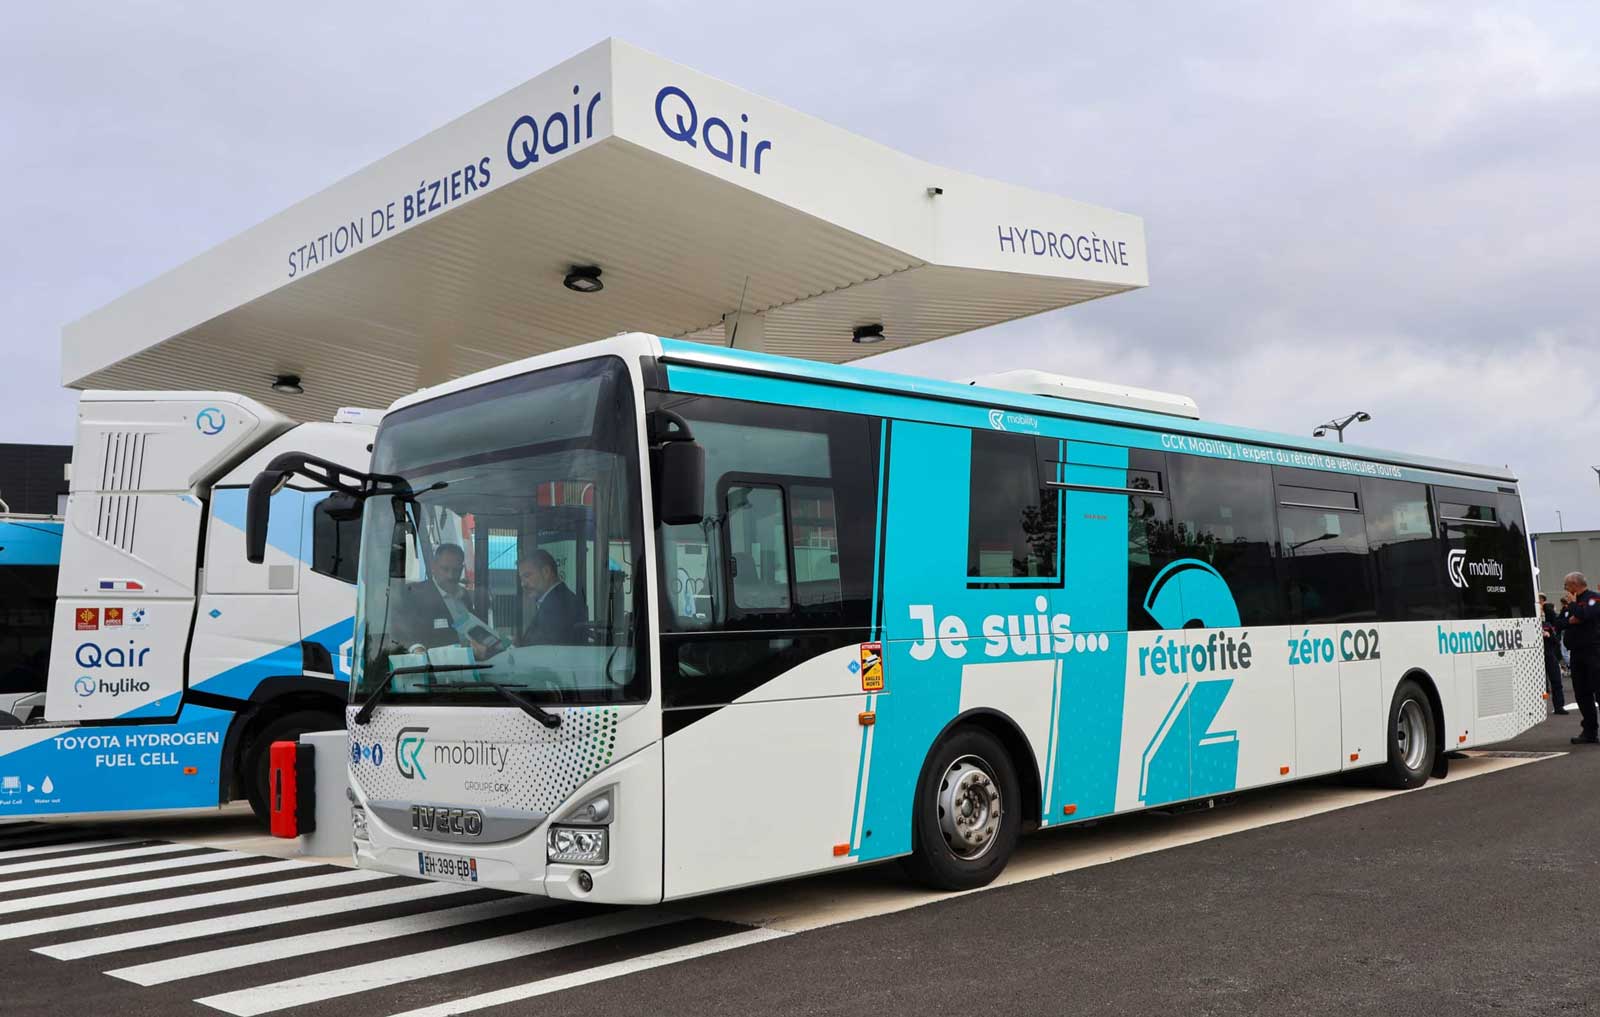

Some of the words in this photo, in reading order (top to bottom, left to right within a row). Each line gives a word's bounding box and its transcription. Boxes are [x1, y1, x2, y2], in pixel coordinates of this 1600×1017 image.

[655, 85, 772, 175] Qair
[288, 215, 364, 277] STATION
[371, 201, 397, 238] DE
[403, 156, 491, 224] BÉZIERS
[507, 84, 601, 170] Qair
[998, 225, 1129, 266] HYDROGÈNE
[1007, 415, 1038, 429] mobility
[1161, 433, 1188, 450] GCK
[1190, 436, 1234, 460] Mobility,
[1236, 443, 1275, 463] l'expert
[1277, 449, 1289, 463] du
[1290, 451, 1324, 468] rétrofit
[1325, 456, 1336, 469] de
[1337, 457, 1377, 474] véhicules
[1377, 463, 1402, 478] lourds
[1469, 558, 1503, 580] mobility
[908, 604, 969, 660] Je
[1288, 629, 1334, 665] zéro
[1340, 628, 1380, 661] CO2
[1437, 623, 1523, 657] homologué
[75, 640, 150, 668] Qair
[1138, 630, 1253, 676] rétrofité
[99, 678, 150, 697] hyliko
[54, 735, 121, 750] TOYOTA
[125, 731, 219, 747] HYDROGEN
[434, 740, 509, 772] mobility
[96, 753, 136, 767] FUEL
[140, 752, 179, 766] CELL
[411, 805, 483, 836] IVECO
